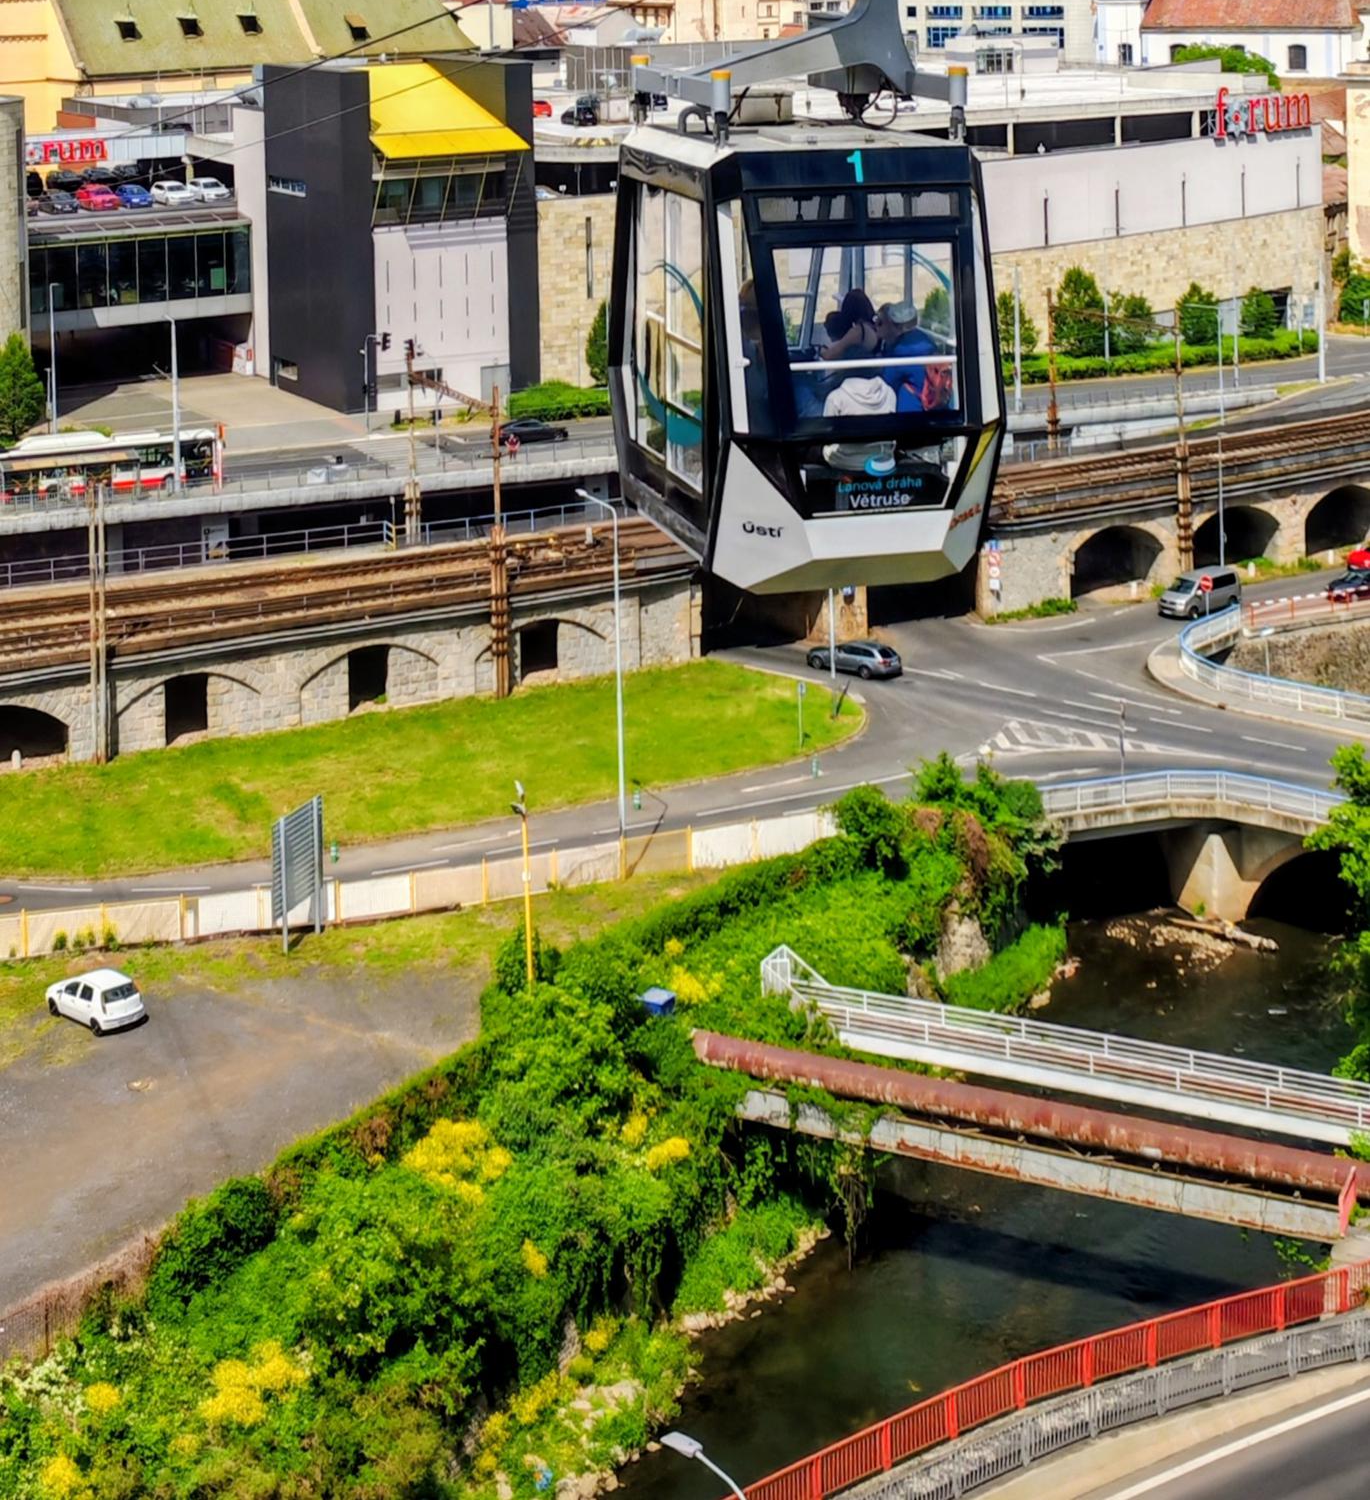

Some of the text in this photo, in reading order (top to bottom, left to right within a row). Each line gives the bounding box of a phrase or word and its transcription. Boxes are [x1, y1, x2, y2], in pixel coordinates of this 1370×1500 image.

[846, 143, 864, 183] 1
[837, 476, 923, 493] Lanová dráha
[849, 491, 911, 508] Větruše
